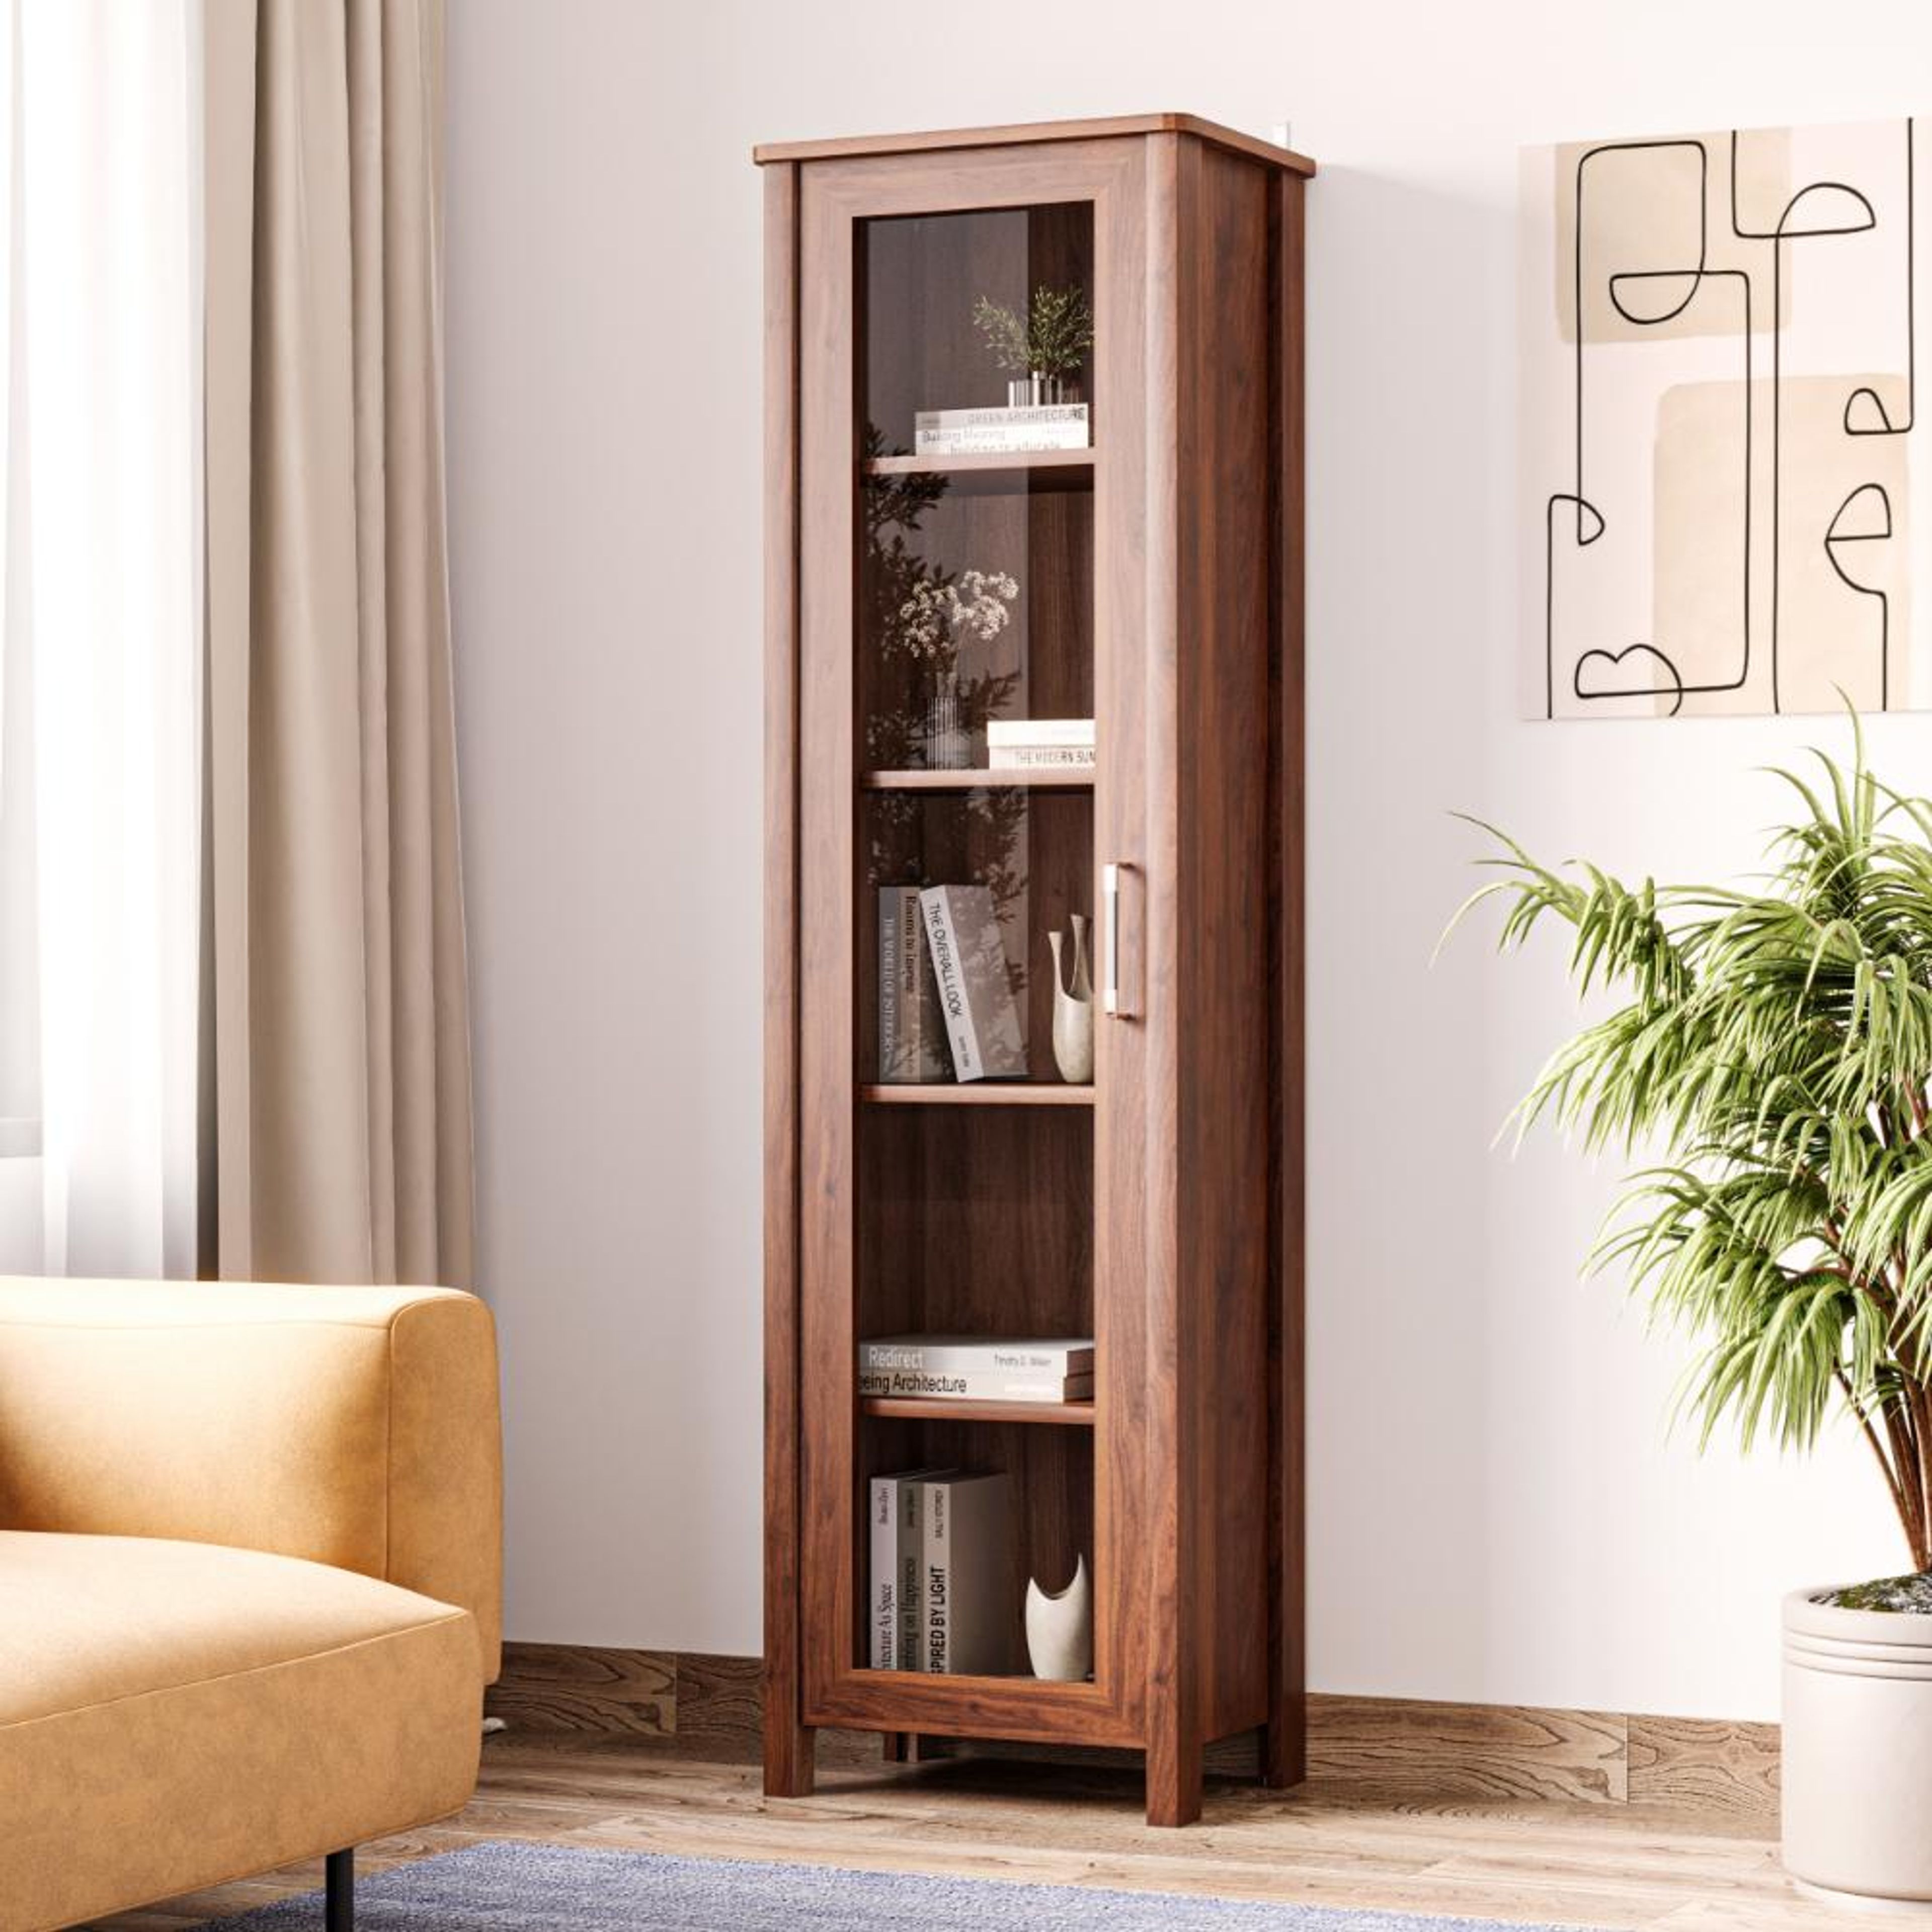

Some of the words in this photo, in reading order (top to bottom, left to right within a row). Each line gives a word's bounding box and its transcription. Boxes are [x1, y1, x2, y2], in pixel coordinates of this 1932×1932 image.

[1008, 407, 1085, 424] ARCHITECTURE
[906, 896, 917, 936] Rooms
[929, 903, 941, 924] THE
[906, 938, 917, 949] to
[933, 925, 955, 988] OVERALL
[946, 986, 964, 1017] LOOK
[869, 1346, 924, 1370] Redirect
[893, 1372, 968, 1393] Architecture
[929, 1565, 946, 1605] LIGHT
[879, 1584, 895, 1612] Space
[930, 1608, 945, 1626] BY
